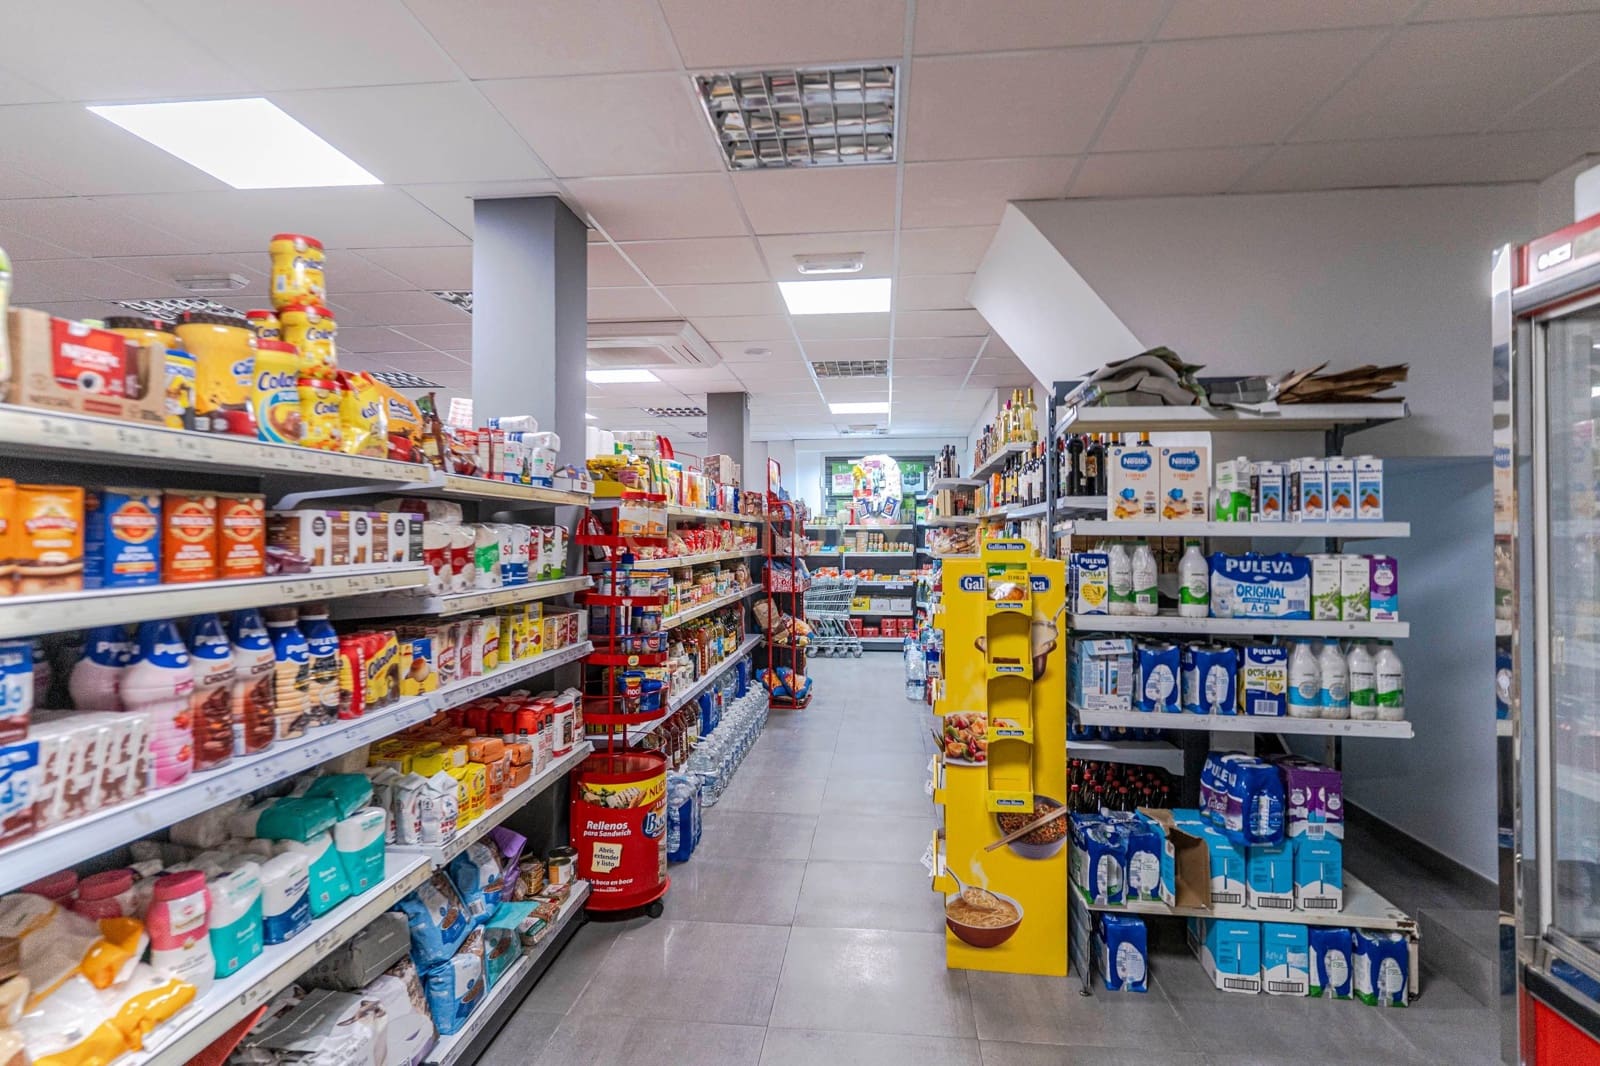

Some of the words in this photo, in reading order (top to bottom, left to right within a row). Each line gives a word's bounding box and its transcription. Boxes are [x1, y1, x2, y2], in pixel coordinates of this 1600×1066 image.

[1080, 557, 1107, 565] PULEVA
[1225, 558, 1294, 575] PULEVA
[1236, 583, 1287, 599] ORIGINAL
[1252, 647, 1282, 655] PULEVA
[586, 820, 629, 830] Rellenos
[599, 829, 632, 838] Sandwich
